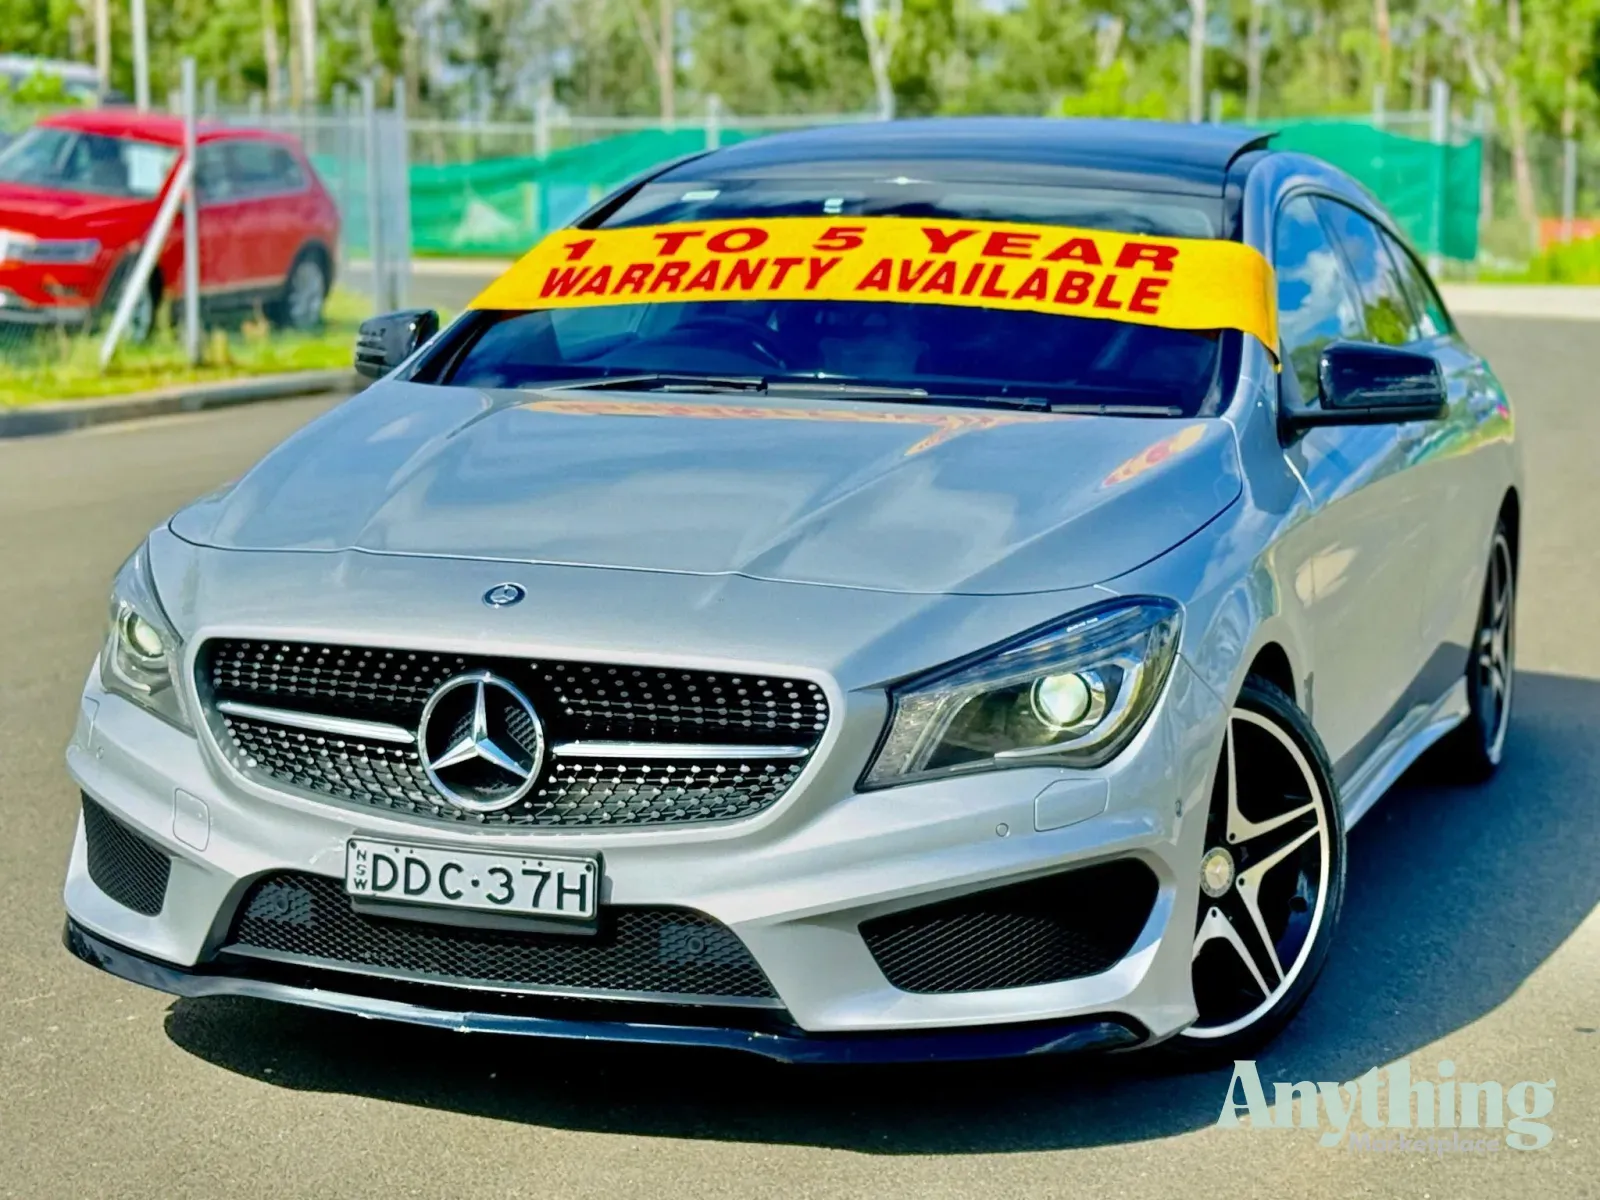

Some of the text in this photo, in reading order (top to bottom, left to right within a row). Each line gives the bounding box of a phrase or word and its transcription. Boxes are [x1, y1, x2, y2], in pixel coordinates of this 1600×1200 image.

[563, 227, 1180, 272] 1 TO 5 YEAR
[539, 257, 1170, 315] WARRANTY AVAILABLE
[353, 850, 367, 890] NSW
